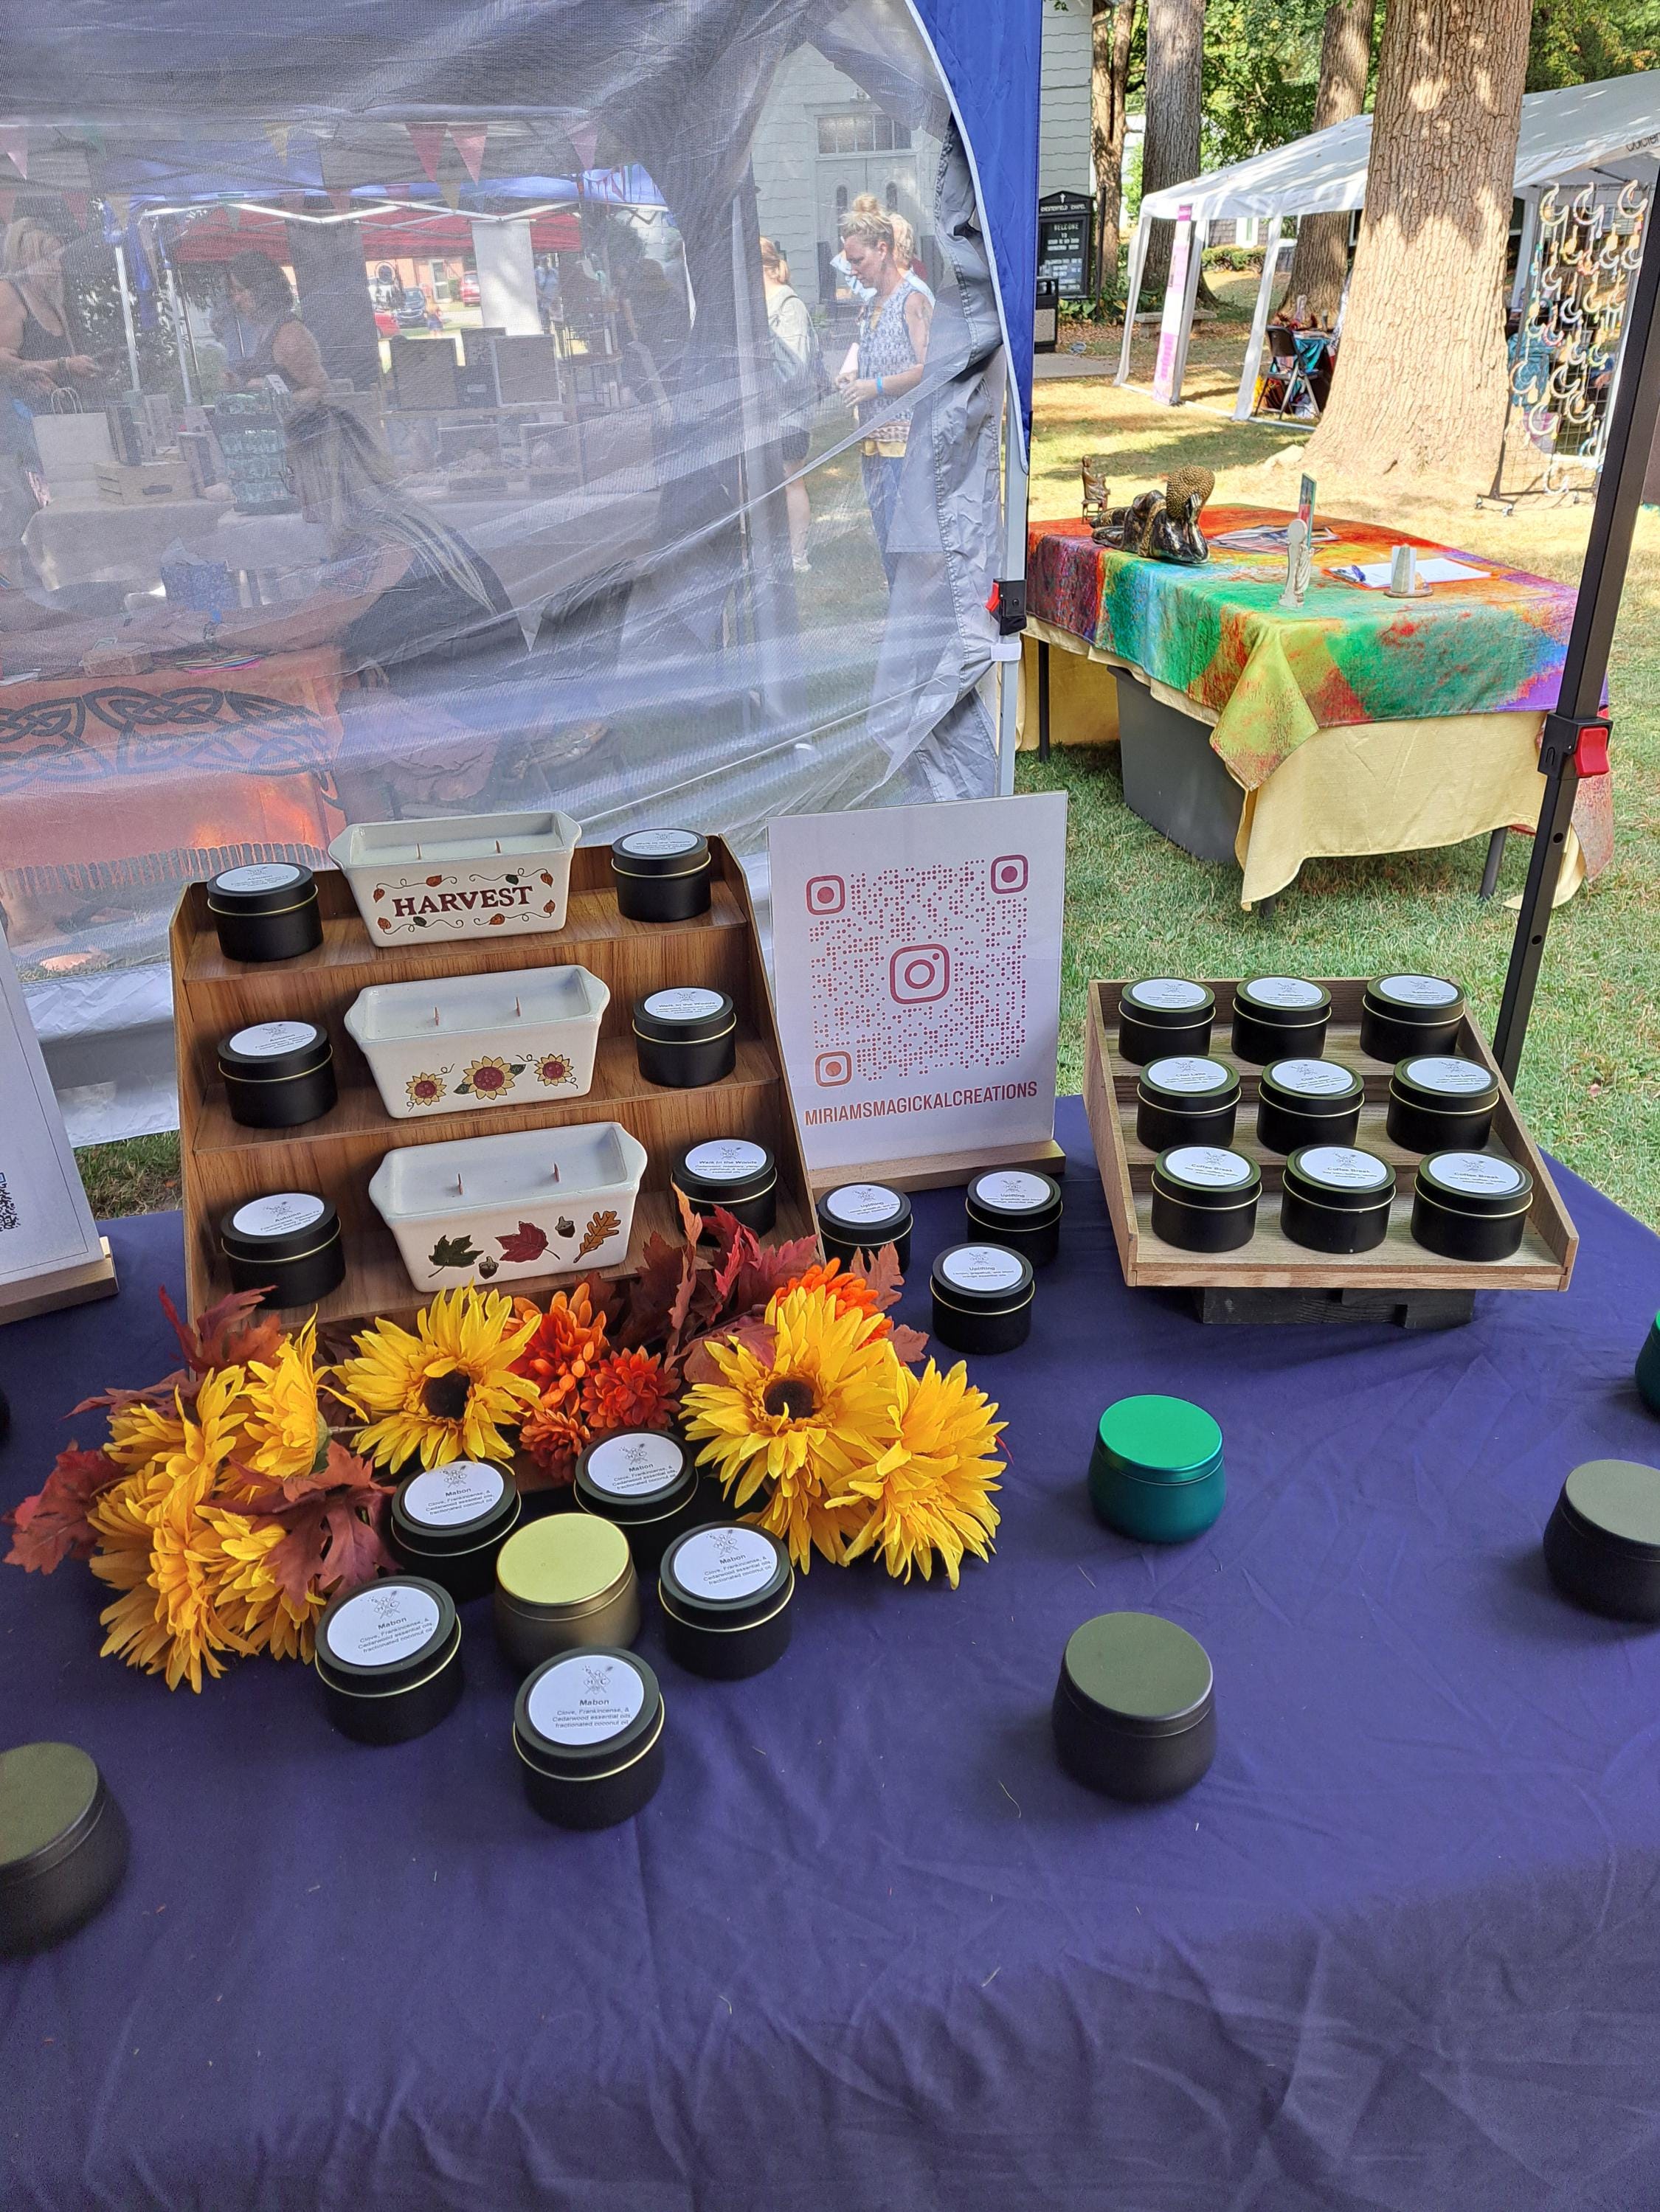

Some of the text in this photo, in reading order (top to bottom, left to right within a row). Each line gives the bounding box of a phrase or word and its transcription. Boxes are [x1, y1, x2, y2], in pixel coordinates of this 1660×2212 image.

[392, 886, 533, 917] HARVEST
[804, 1081, 1038, 1126] MIRIAMSMAGICKALCREATIONS
[629, 1463, 654, 1473] Mabon
[445, 1488, 471, 1497] Mabon
[719, 1554, 746, 1564] Mabon
[360, 1634, 380, 1643] Clove,
[381, 1620, 423, 1636] Frankincense,
[378, 1617, 407, 1630] Mabon
[358, 1635, 393, 1649] Cedarwood
[395, 1626, 421, 1637] essential
[363, 1639, 399, 1653] fractionated
[400, 1632, 424, 1641] coconut
